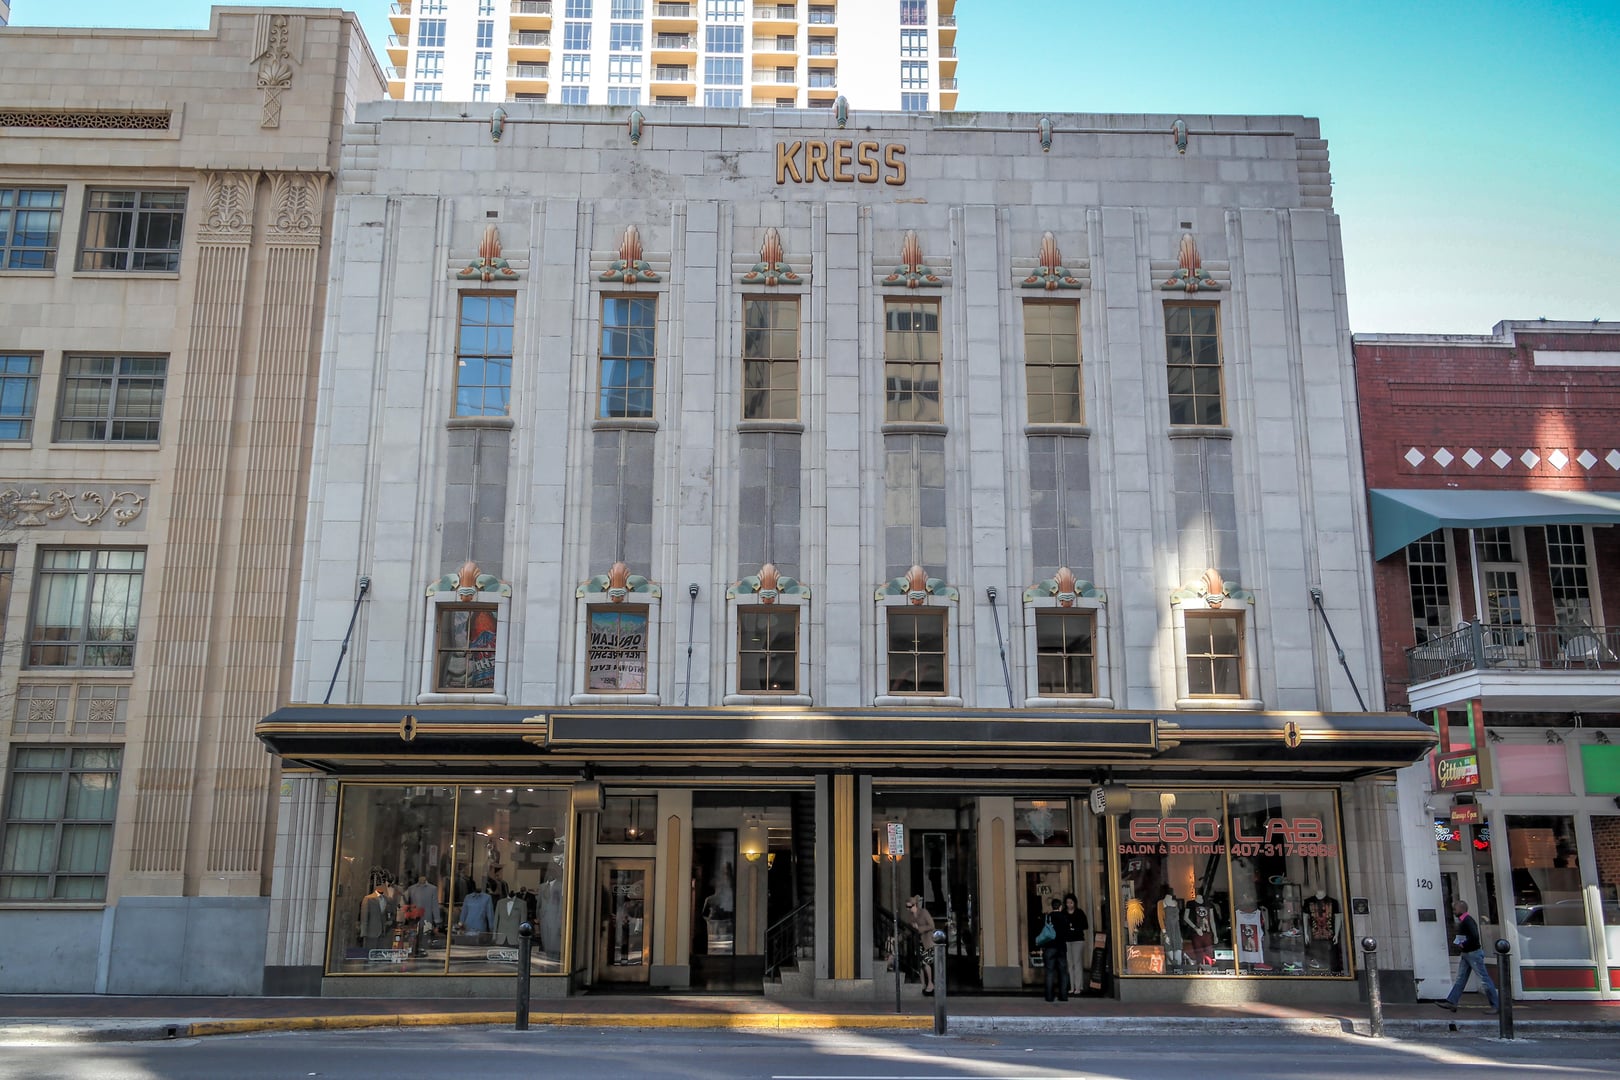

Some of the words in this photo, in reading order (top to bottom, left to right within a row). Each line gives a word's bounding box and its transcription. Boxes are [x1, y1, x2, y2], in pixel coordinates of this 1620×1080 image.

[776, 140, 906, 185] KRESS
[1130, 817, 1219, 842] EGO
[1234, 818, 1323, 843] LAB
[1118, 844, 1155, 854] SALON
[1159, 844, 1167, 854] &
[1170, 844, 1225, 854] BOUTIQUE
[1417, 879, 1433, 890] 120
